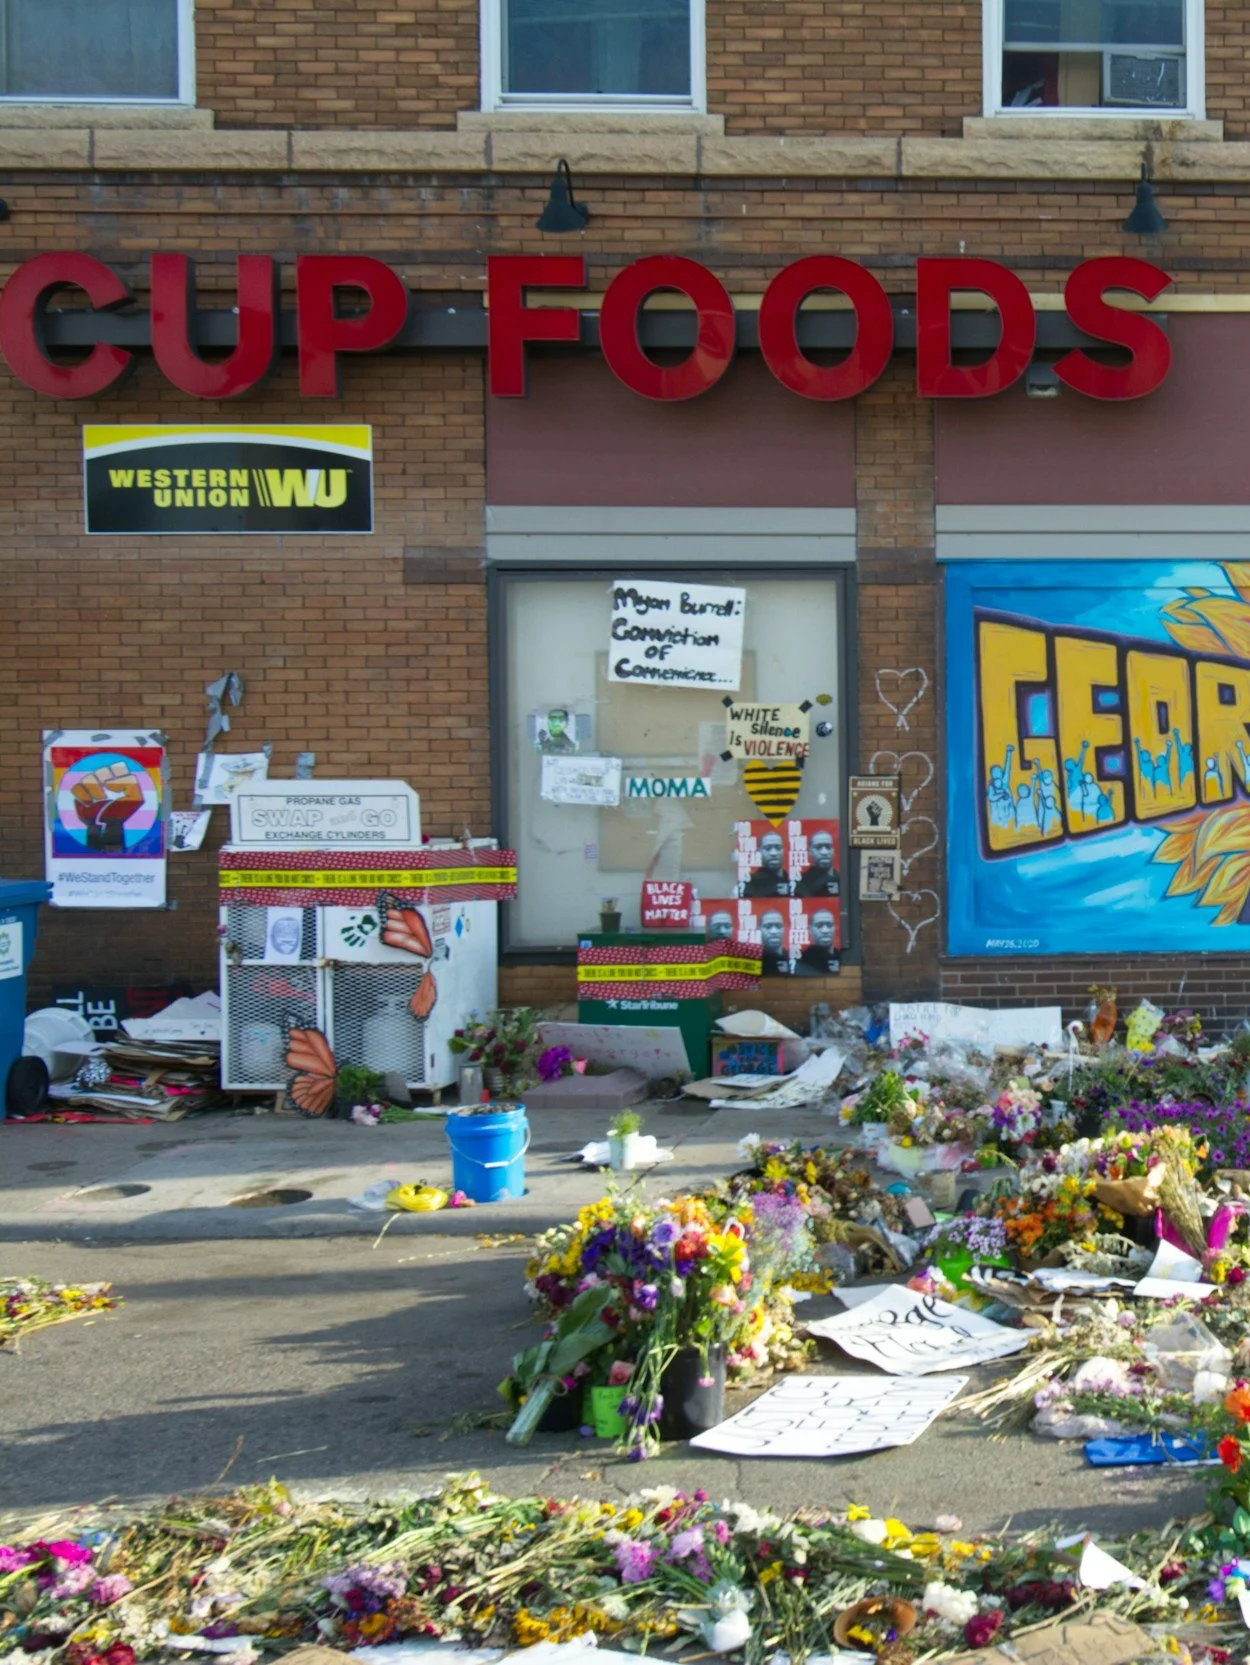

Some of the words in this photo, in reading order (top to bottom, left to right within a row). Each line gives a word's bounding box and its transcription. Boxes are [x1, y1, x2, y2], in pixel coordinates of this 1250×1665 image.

[0, 250, 408, 399] CUP
[487, 255, 1173, 401] FOODS
[109, 468, 249, 487] WESTERN
[264, 468, 348, 508] WU
[154, 489, 249, 508] UNION
[611, 617, 719, 646] Conviction
[730, 707, 780, 721] WHITE
[743, 739, 810, 758] VIOLENCE
[628, 777, 708, 798] MOMA
[286, 797, 336, 805] PROPANE
[338, 797, 361, 805] GAS
[252, 809, 324, 827] SWAP
[361, 809, 397, 827] GO
[265, 831, 323, 840] EXCHANGE
[326, 831, 386, 840] CYLINDERS
[58, 871, 156, 885] #WeStandTogether
[646, 882, 685, 896] BLACK
[651, 895, 682, 906] LIVES
[644, 908, 688, 921] MATTER
